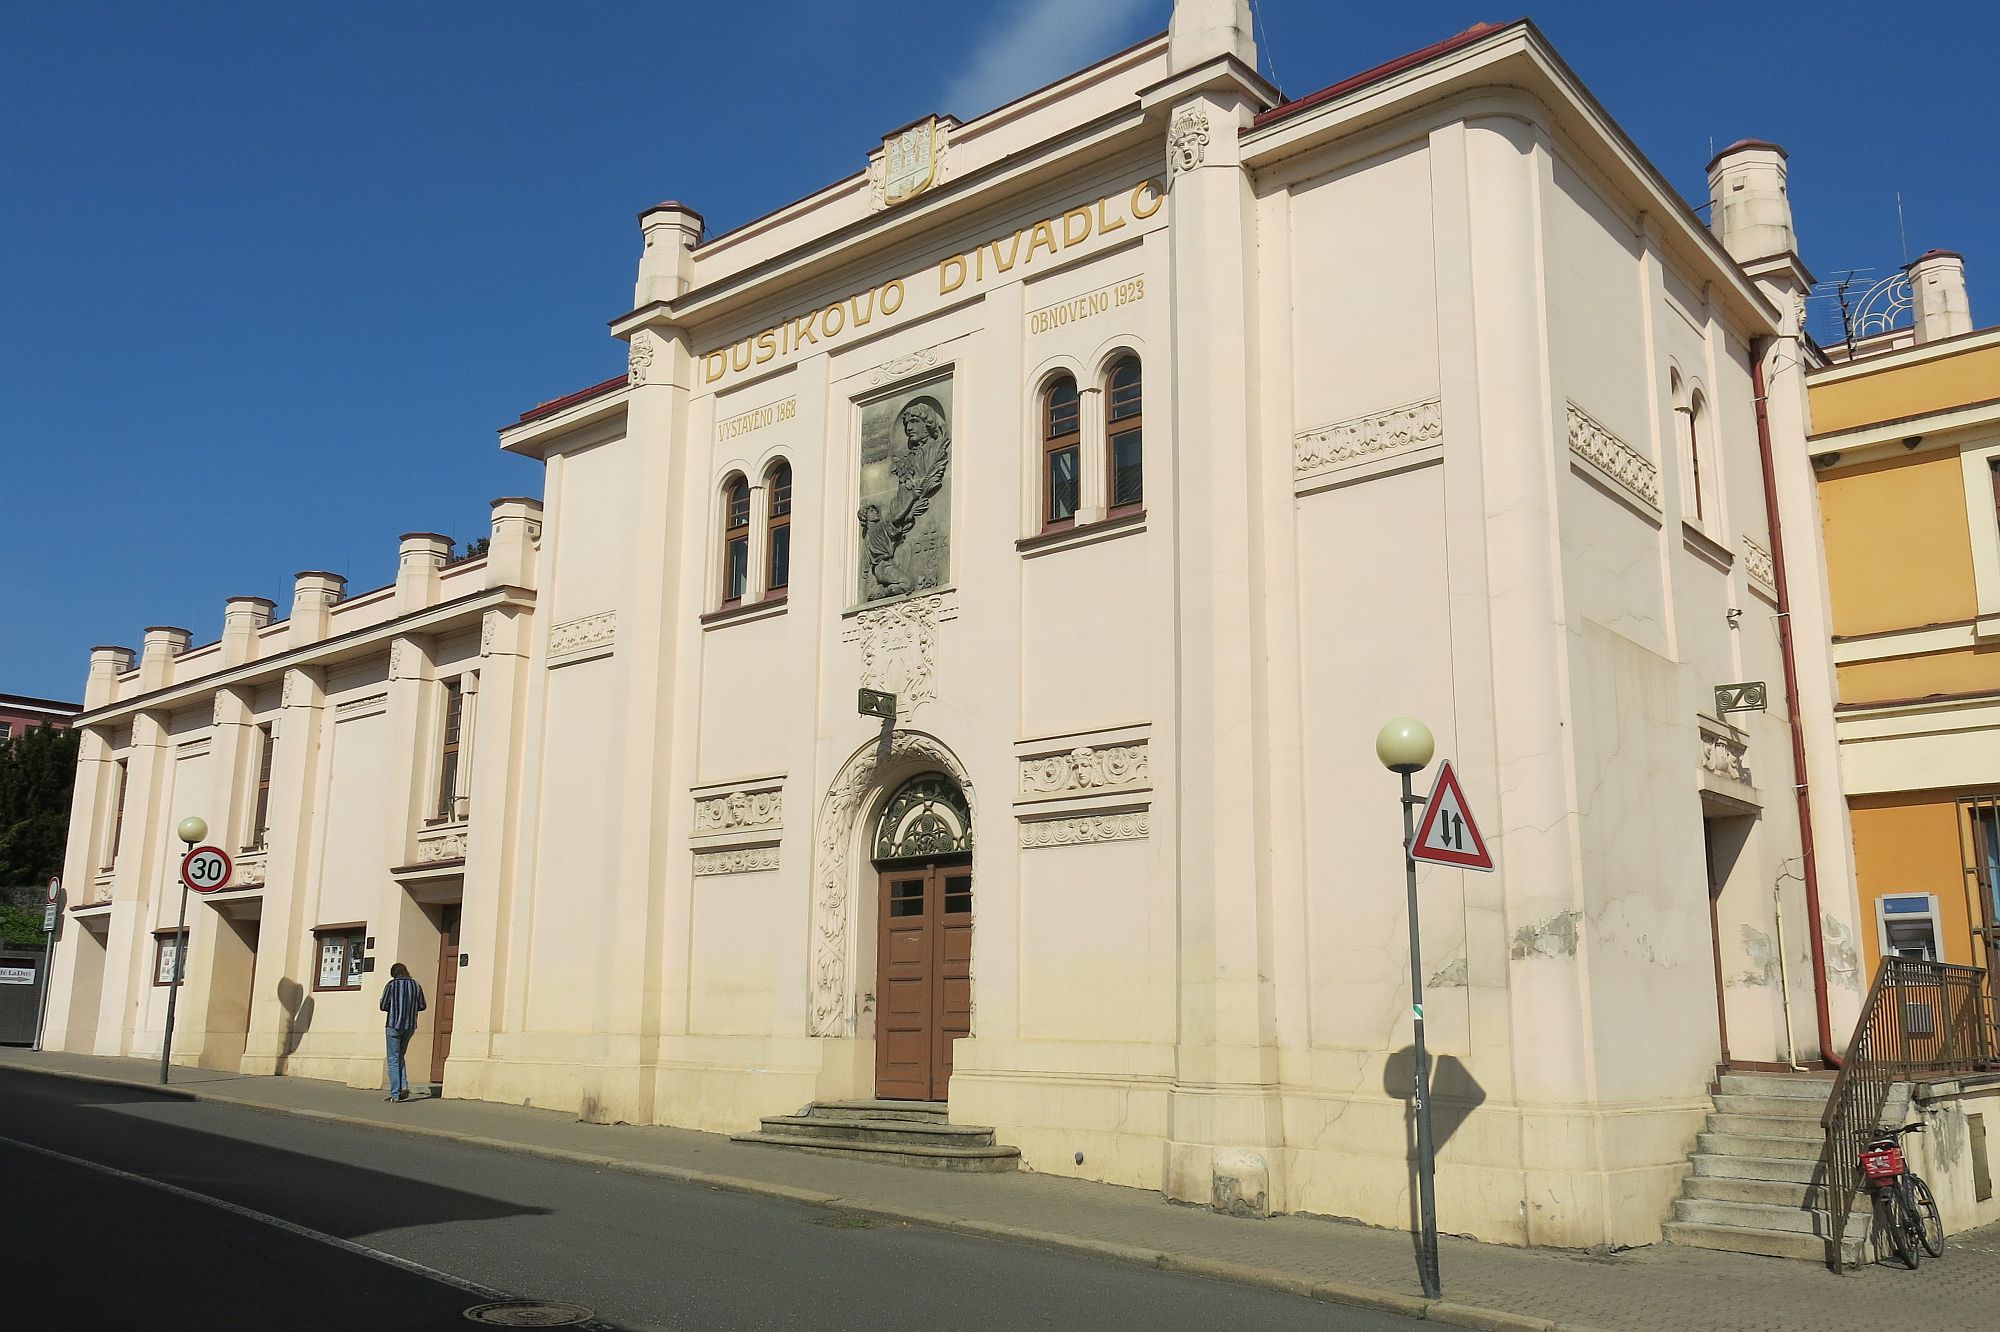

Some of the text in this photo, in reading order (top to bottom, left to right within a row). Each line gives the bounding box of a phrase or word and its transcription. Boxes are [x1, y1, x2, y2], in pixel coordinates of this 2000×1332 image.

[939, 178, 1164, 296] DIVADLO
[1030, 279, 1145, 335] OBNOVENO 1923
[776, 399, 797, 423] 1868
[191, 857, 223, 881] 30
